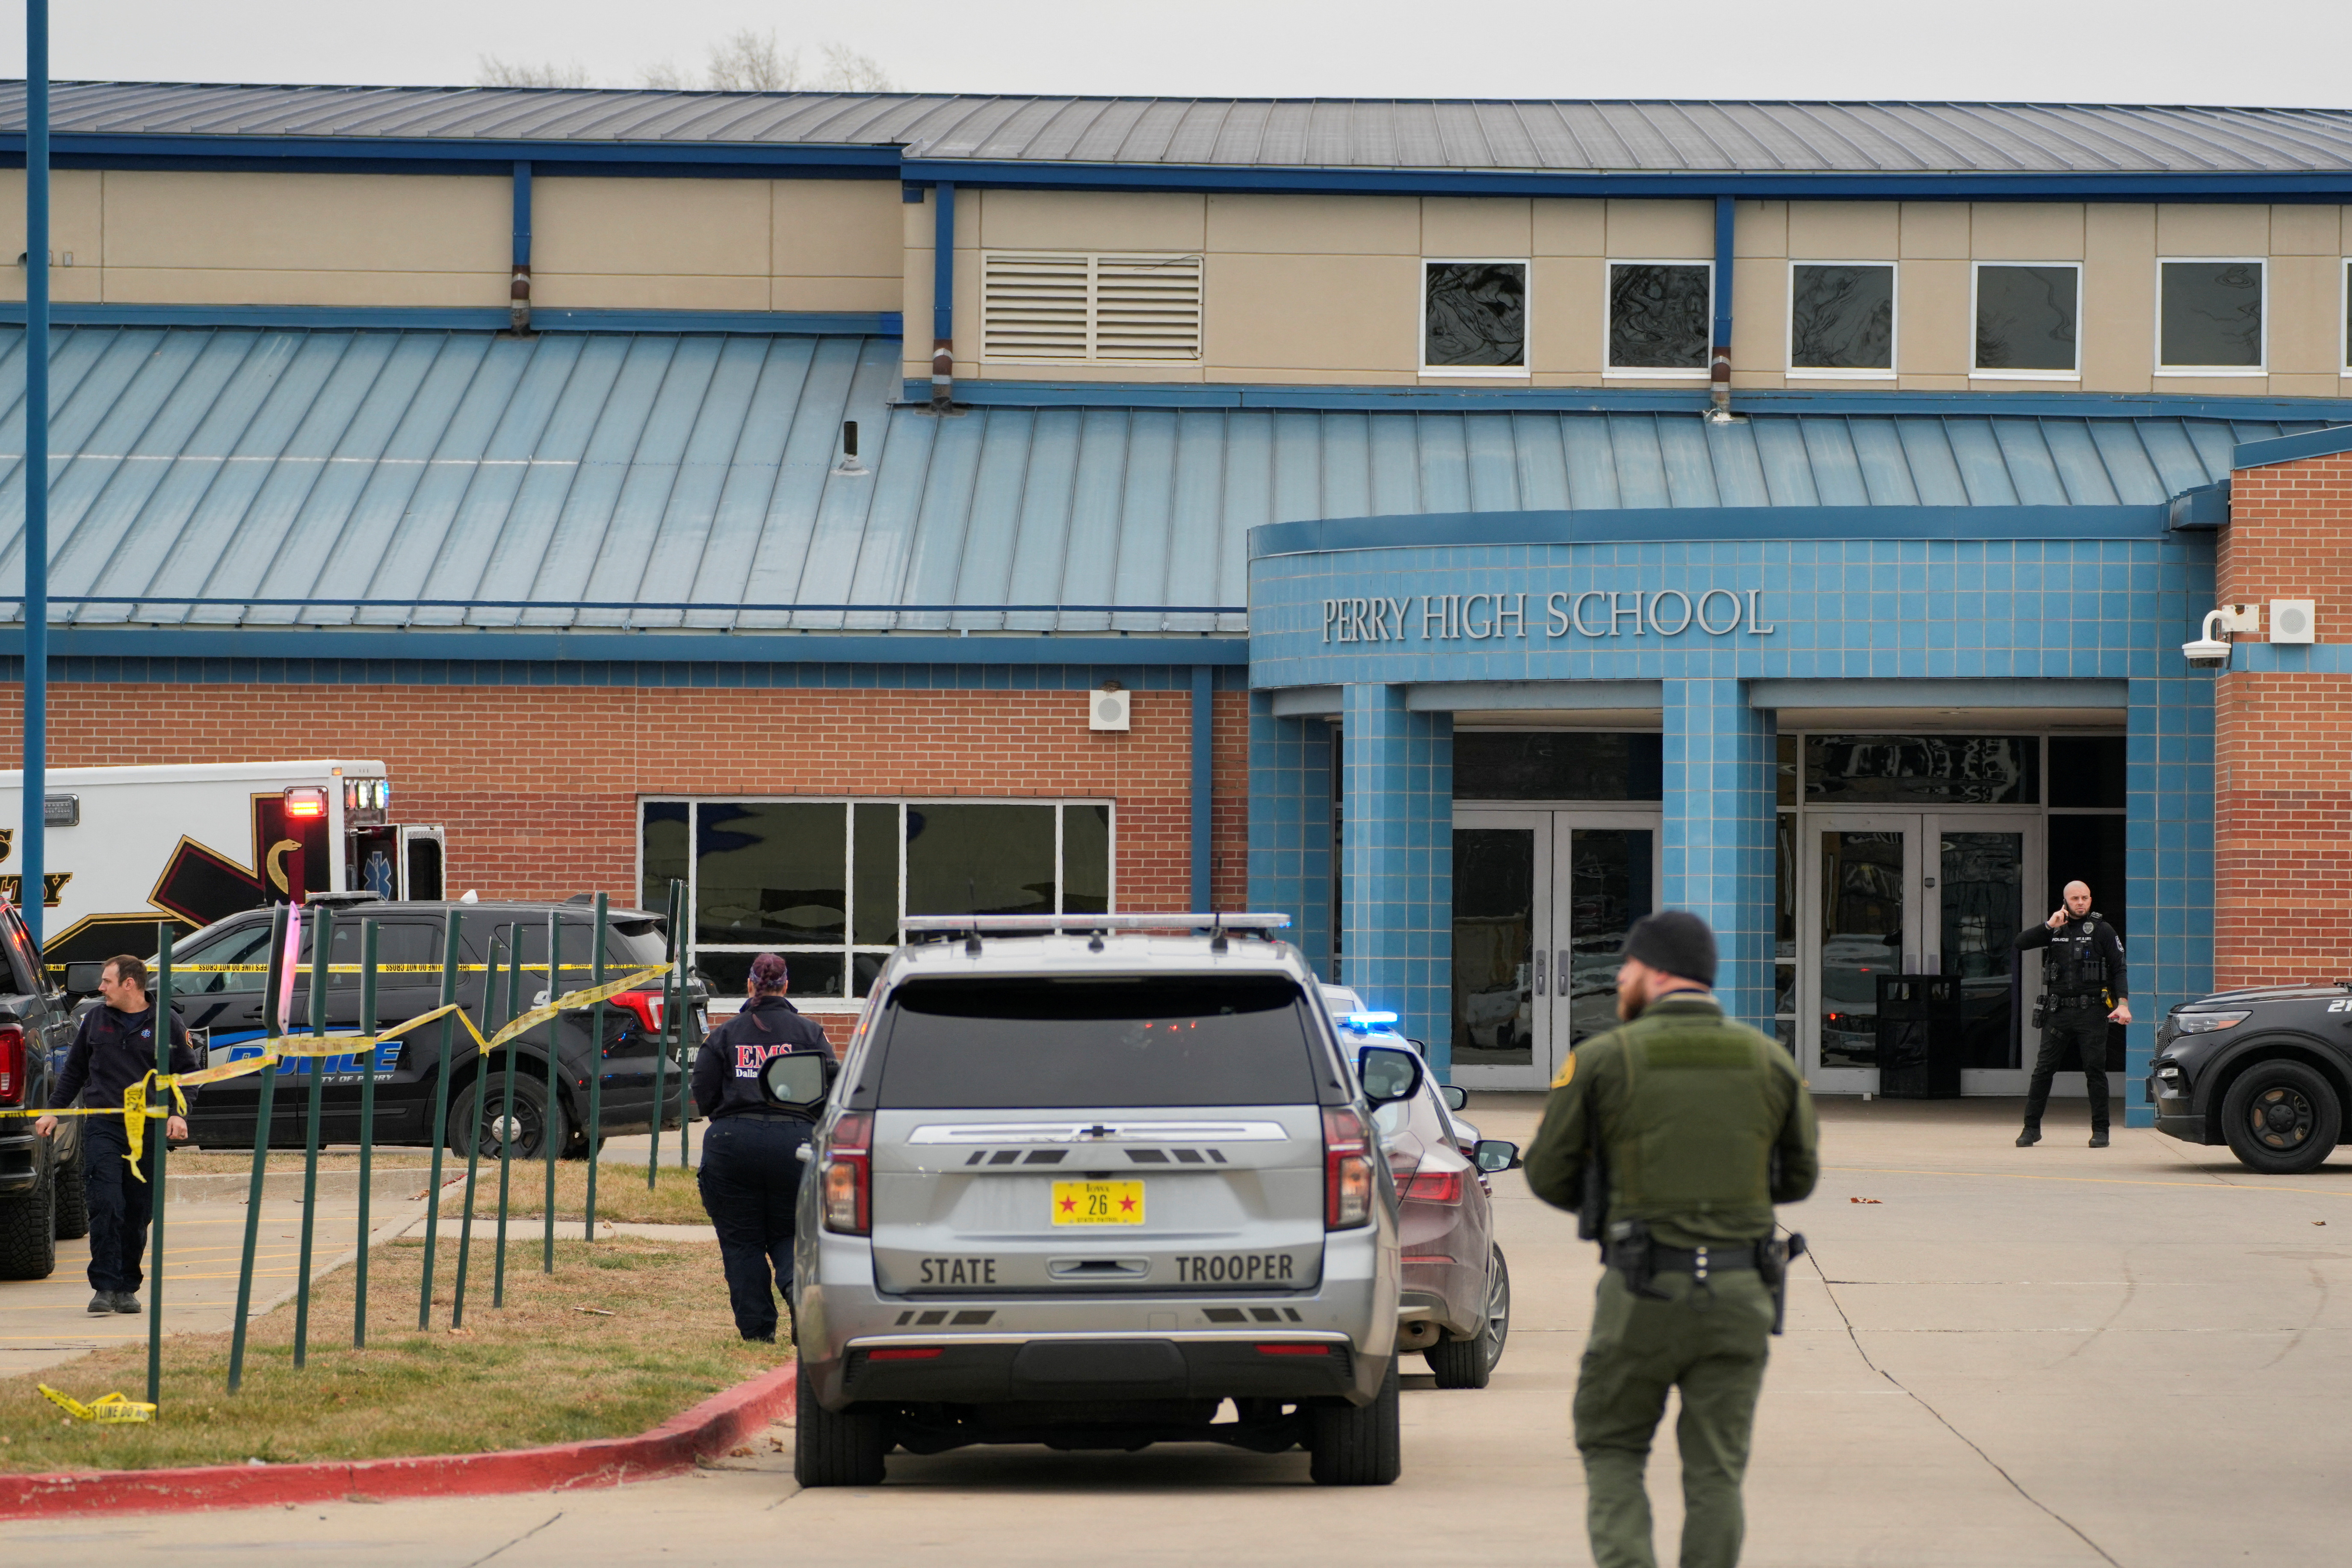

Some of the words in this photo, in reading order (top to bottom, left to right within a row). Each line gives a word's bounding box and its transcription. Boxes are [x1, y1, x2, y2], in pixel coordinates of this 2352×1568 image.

[1322, 596, 1412, 643] PERRY
[1421, 593, 1526, 639] HIGH
[1546, 588, 1774, 638] SCHOOL
[736, 1069, 758, 1078] Dalla
[1089, 1195, 1107, 1215] 26
[921, 1258, 996, 1283] STATE
[1176, 1254, 1294, 1282] TROOPER
[99, 1405, 118, 1418] LINE
